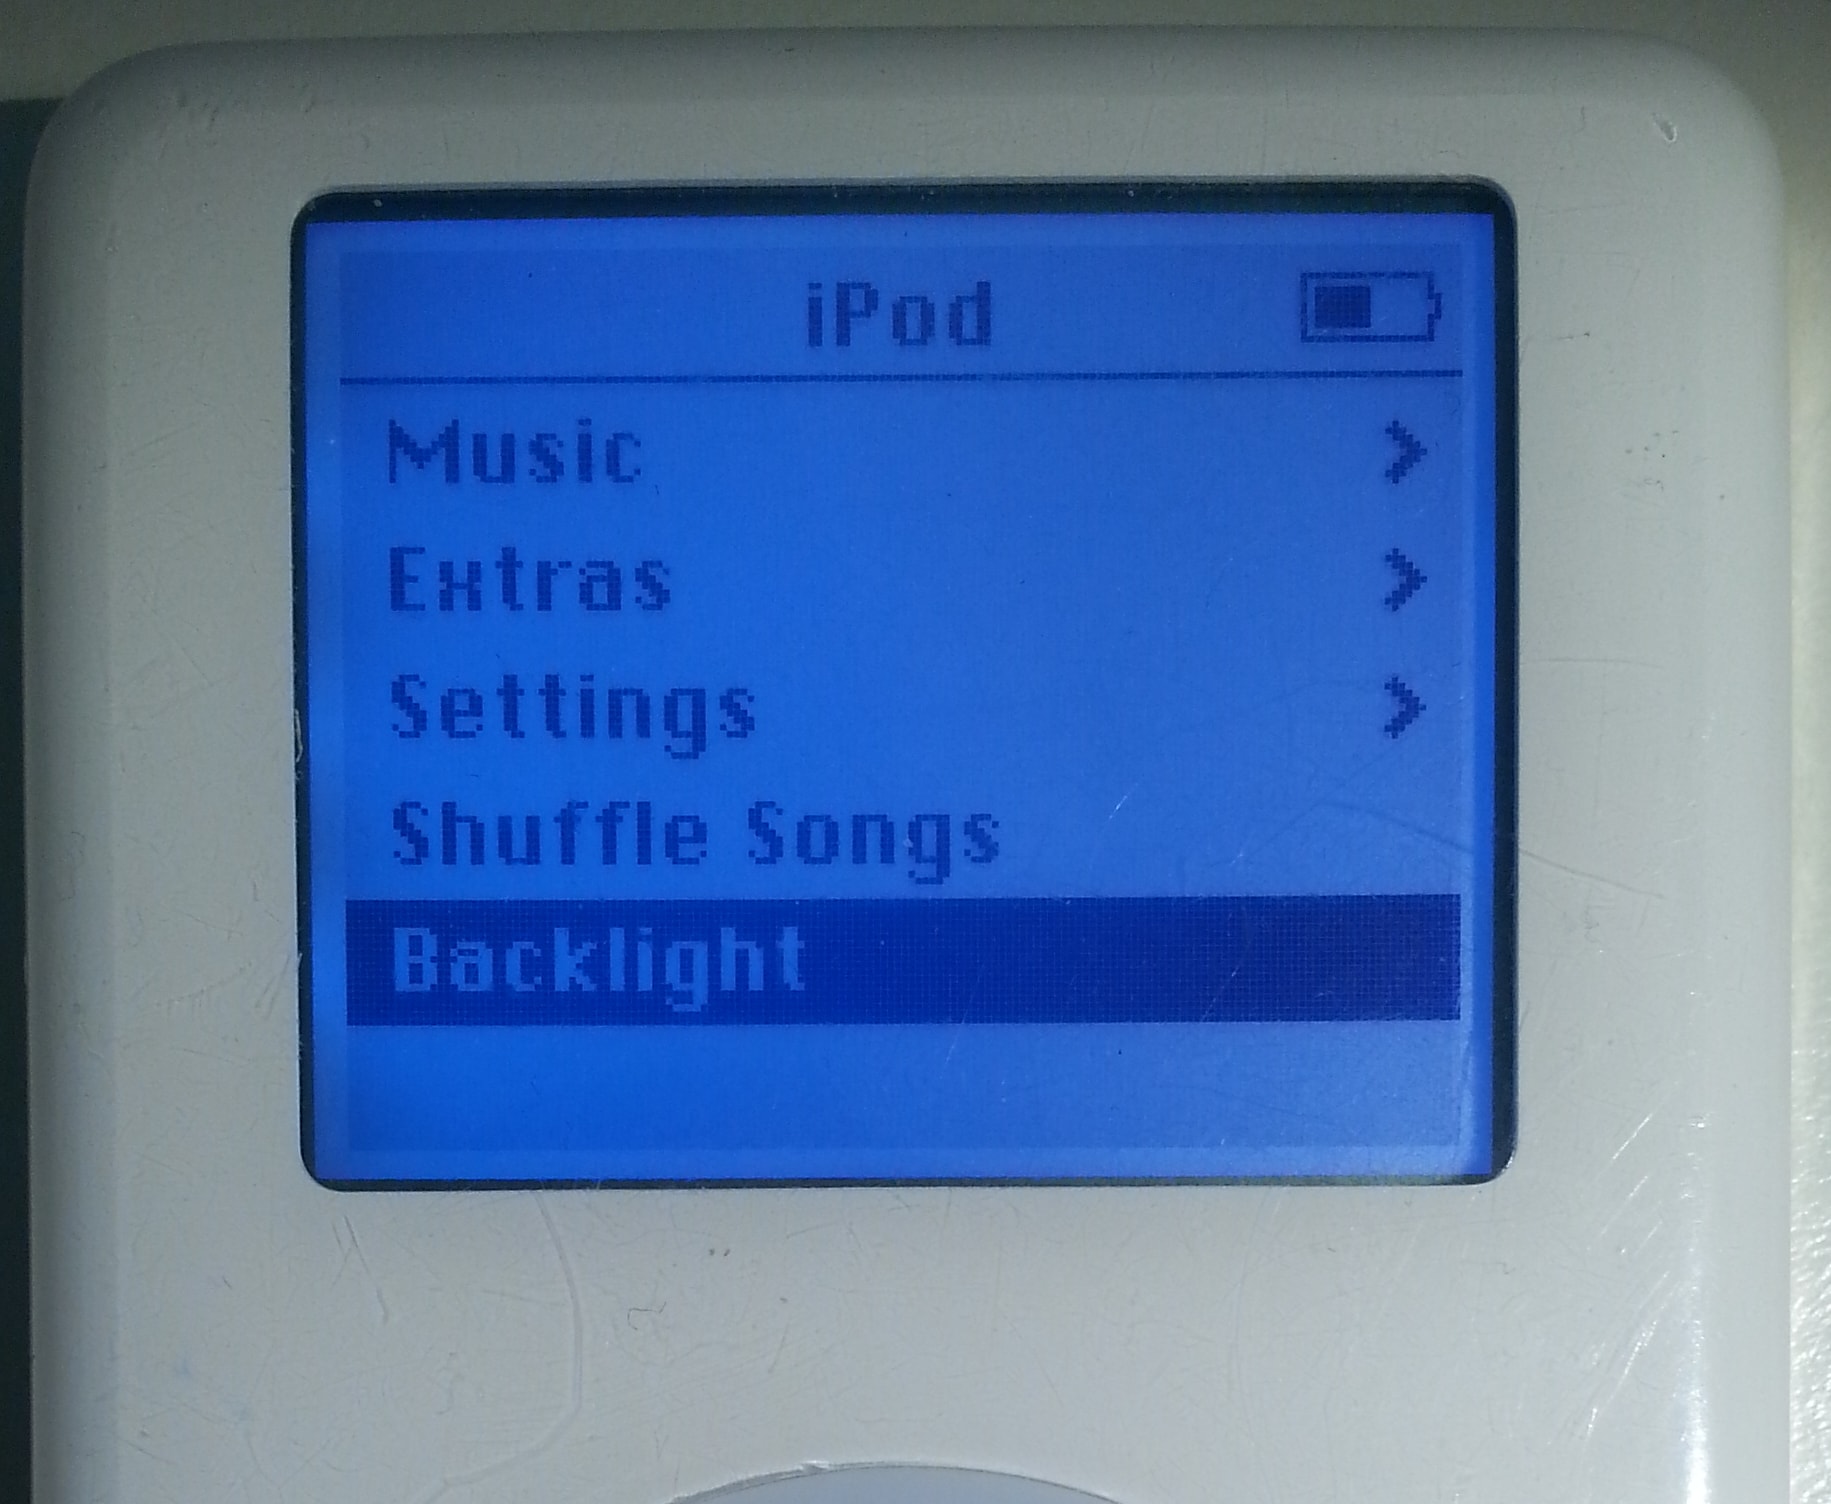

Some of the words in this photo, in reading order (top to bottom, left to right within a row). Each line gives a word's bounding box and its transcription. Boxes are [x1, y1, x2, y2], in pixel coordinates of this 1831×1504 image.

[806, 279, 992, 349] iPod
[387, 419, 643, 485] Music
[388, 545, 673, 613] Extras
[391, 672, 758, 760] Settings
[393, 800, 708, 867] Shuffle
[748, 802, 1001, 885] Songs
[393, 925, 806, 1012] Backlight
